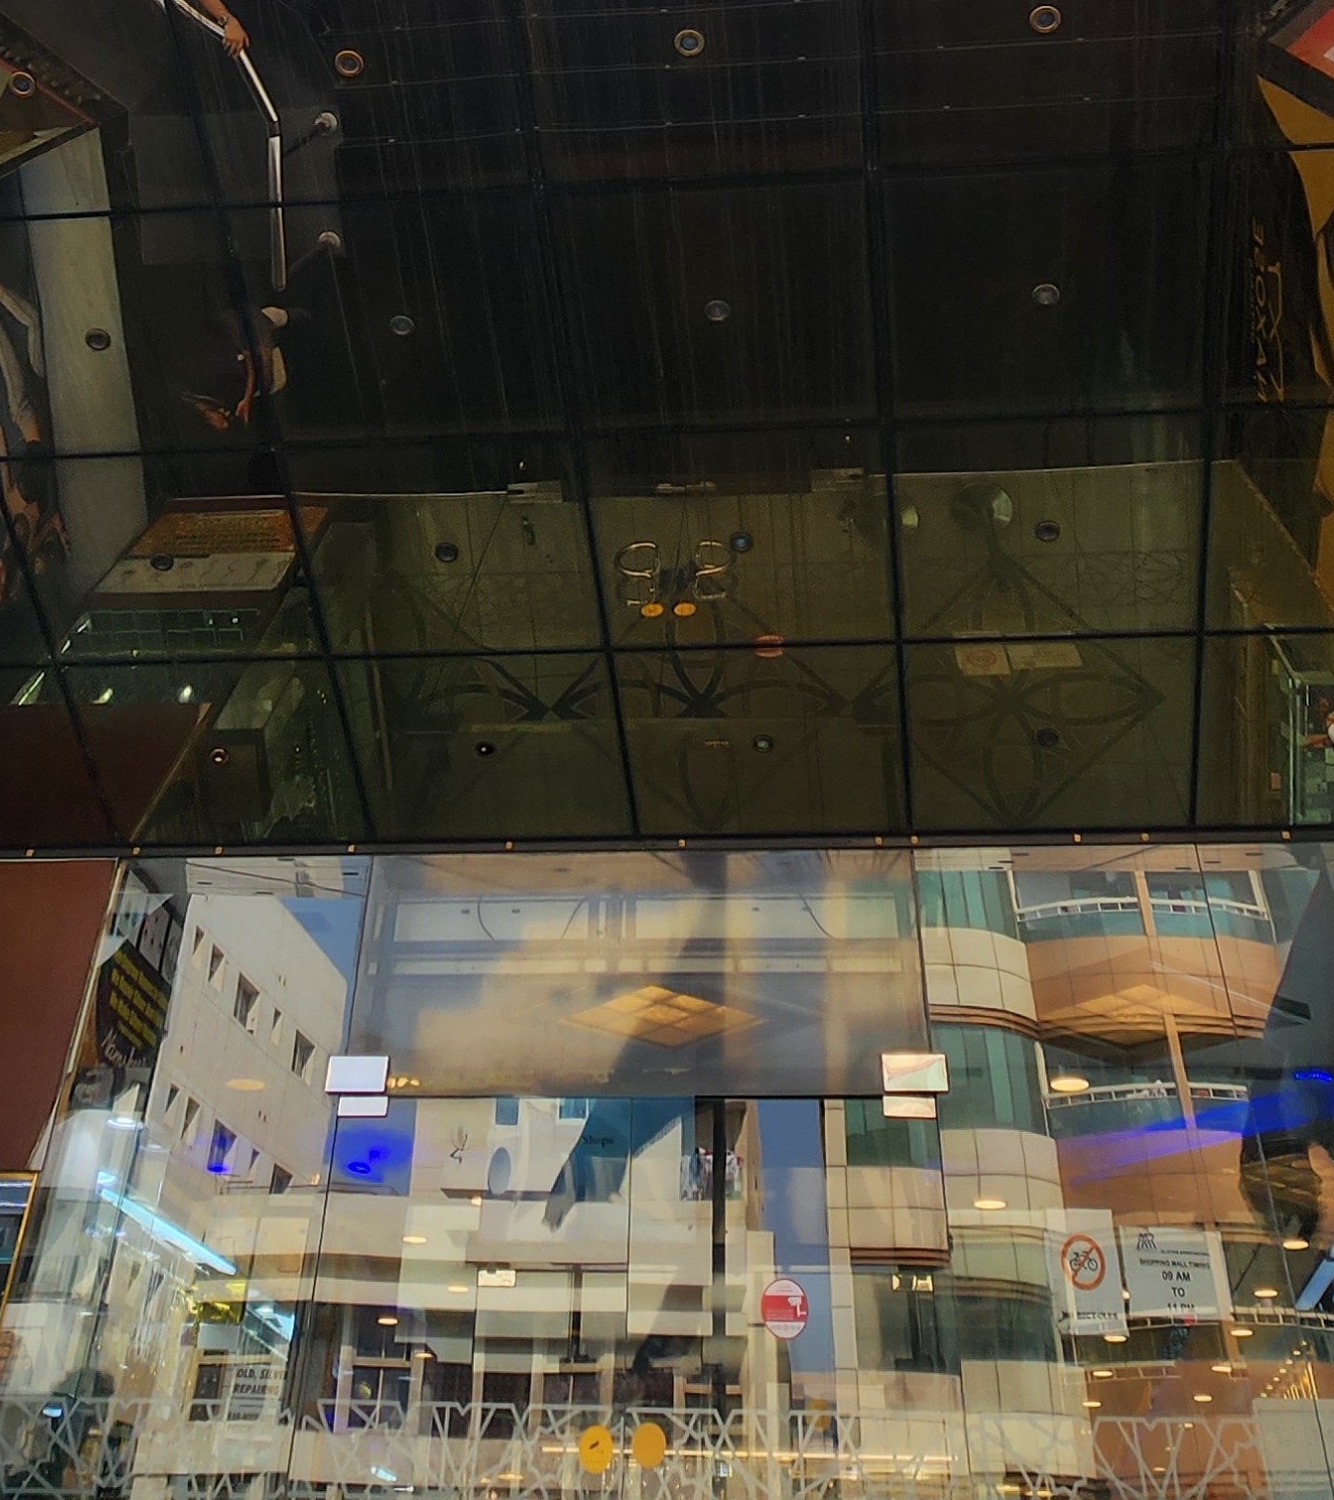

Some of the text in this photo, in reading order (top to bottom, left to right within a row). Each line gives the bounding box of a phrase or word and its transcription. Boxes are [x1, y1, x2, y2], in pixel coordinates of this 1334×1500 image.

[1161, 1270, 1192, 1283] 09 AM
[1171, 1286, 1186, 1298] TO
